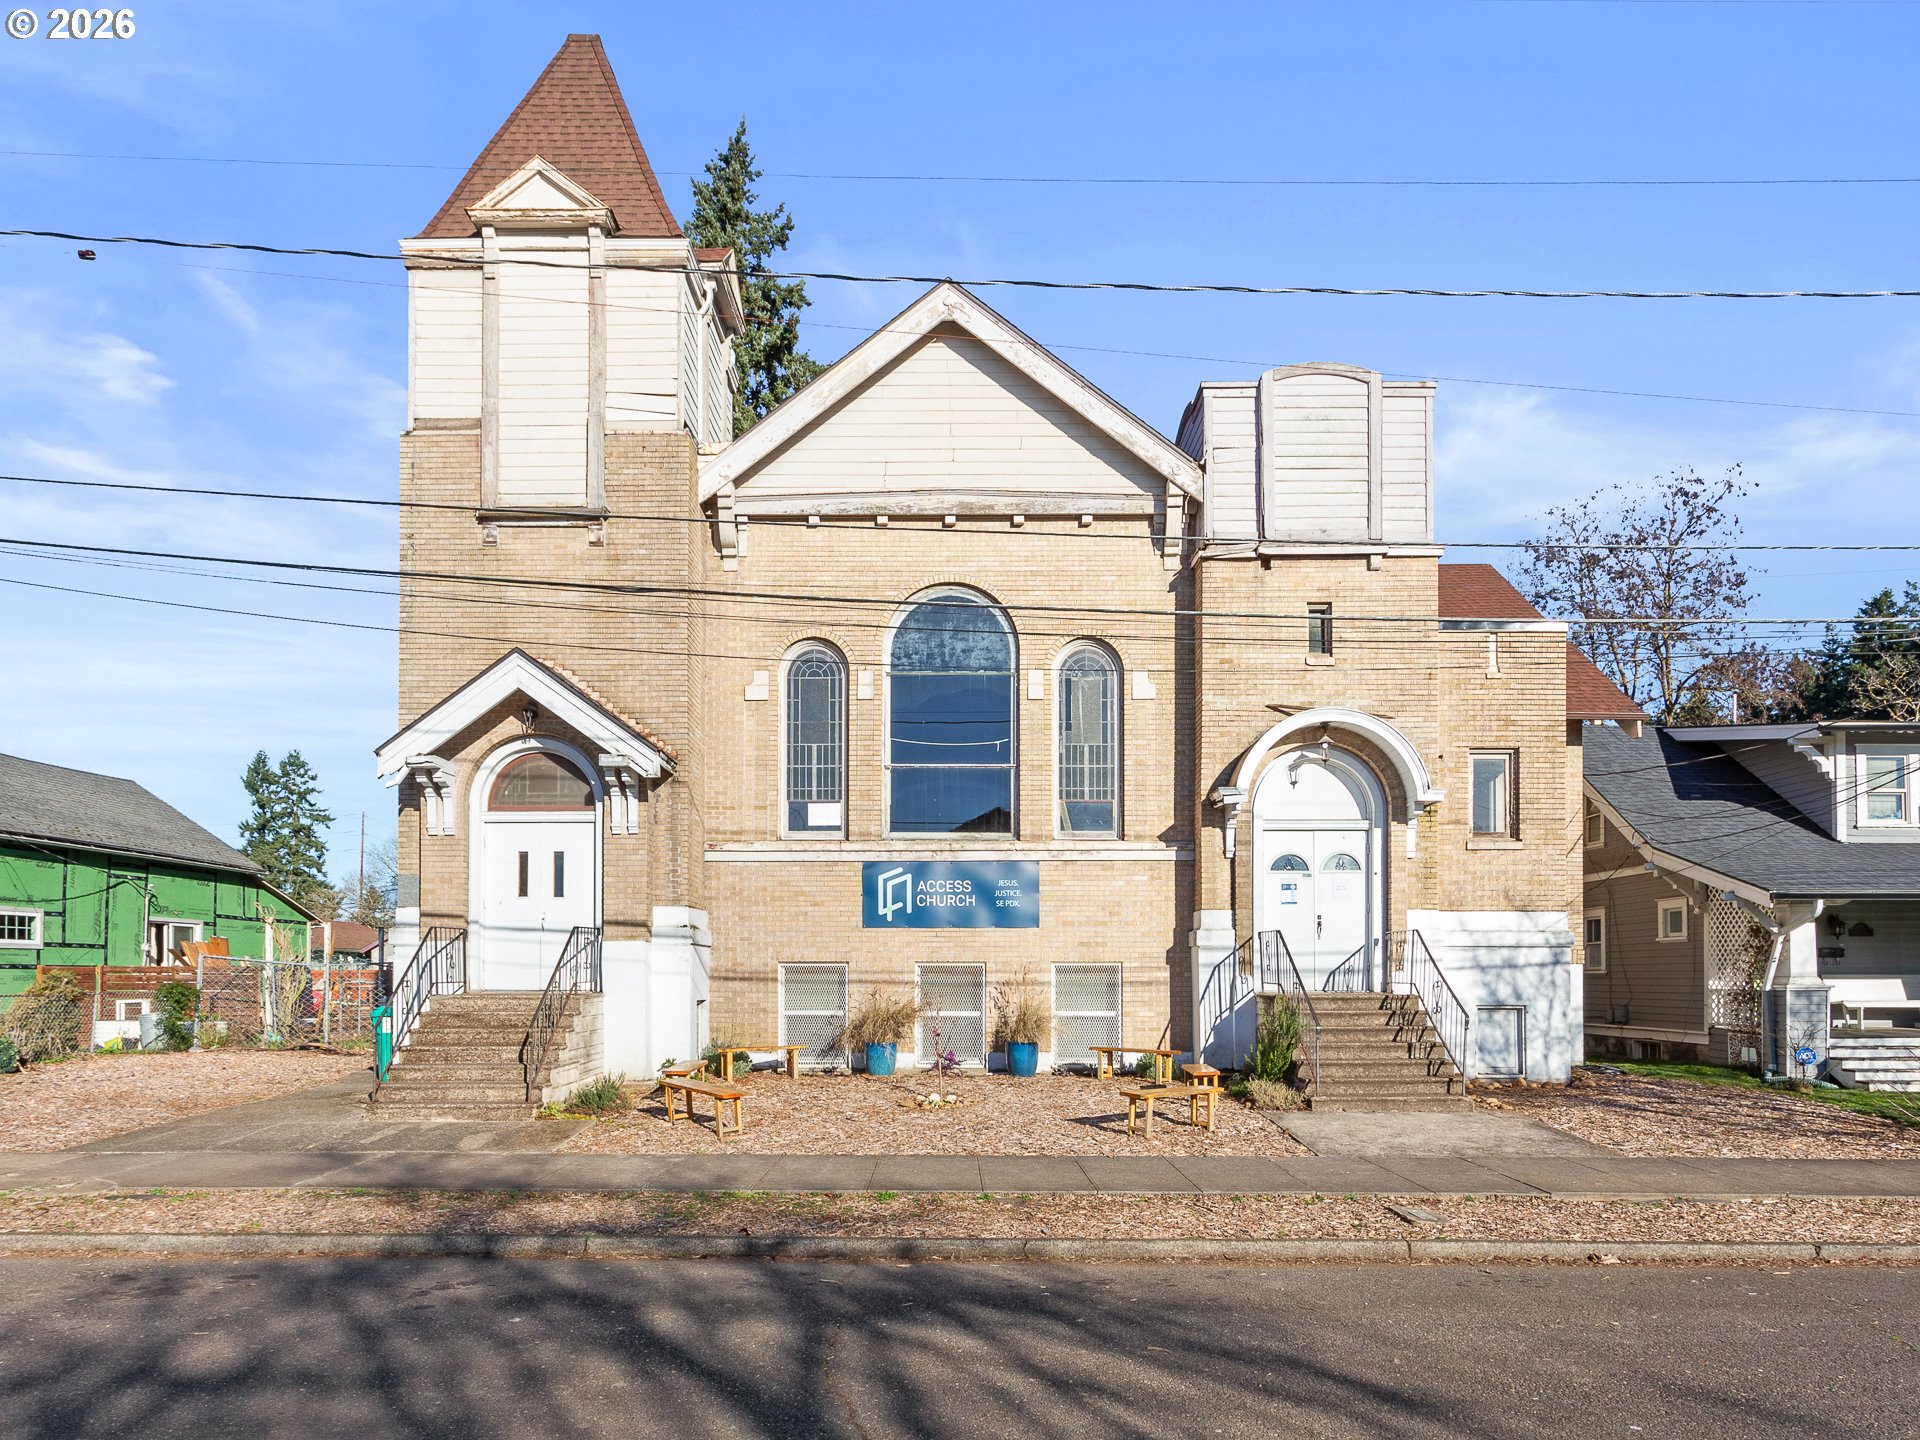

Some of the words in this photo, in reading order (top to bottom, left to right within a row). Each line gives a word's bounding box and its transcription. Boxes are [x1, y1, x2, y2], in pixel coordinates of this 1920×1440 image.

[917, 880, 972, 892] ACCESS
[997, 879, 1020, 887] JESUS.
[994, 889, 1023, 897] JUSTICE.
[916, 894, 976, 907] CHURCH
[995, 899, 1004, 907] SE
[1005, 899, 1021, 907] PDX.
